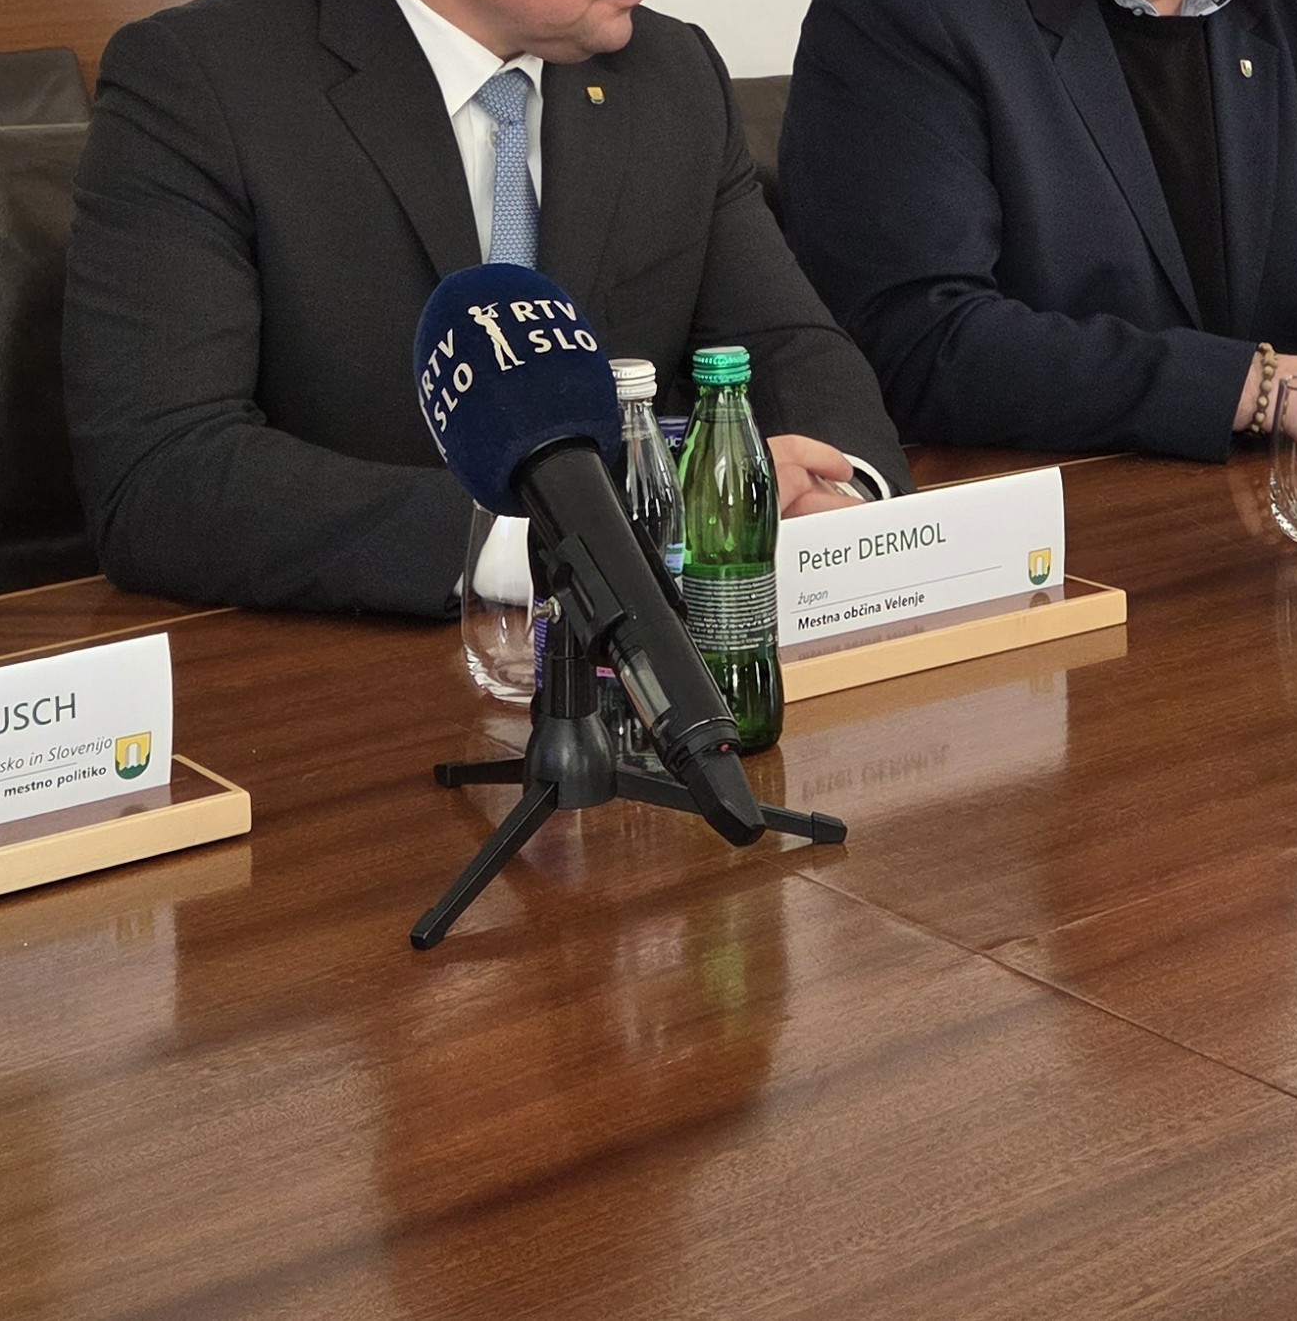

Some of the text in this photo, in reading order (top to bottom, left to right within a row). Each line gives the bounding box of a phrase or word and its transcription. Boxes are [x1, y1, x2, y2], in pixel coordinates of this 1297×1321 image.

[510, 299, 577, 322] RTV
[528, 328, 597, 353] SLO
[421, 328, 453, 400] RTV
[433, 362, 473, 433] SLO
[799, 523, 946, 572] Peter DERMOL
[798, 589, 828, 604] župan
[798, 592, 925, 630] Mestna občina Velenje
[28, 751, 44, 767] in
[47, 735, 113, 762] Slovenijo
[4, 775, 53, 798] mestno
[57, 764, 107, 788] politiko
